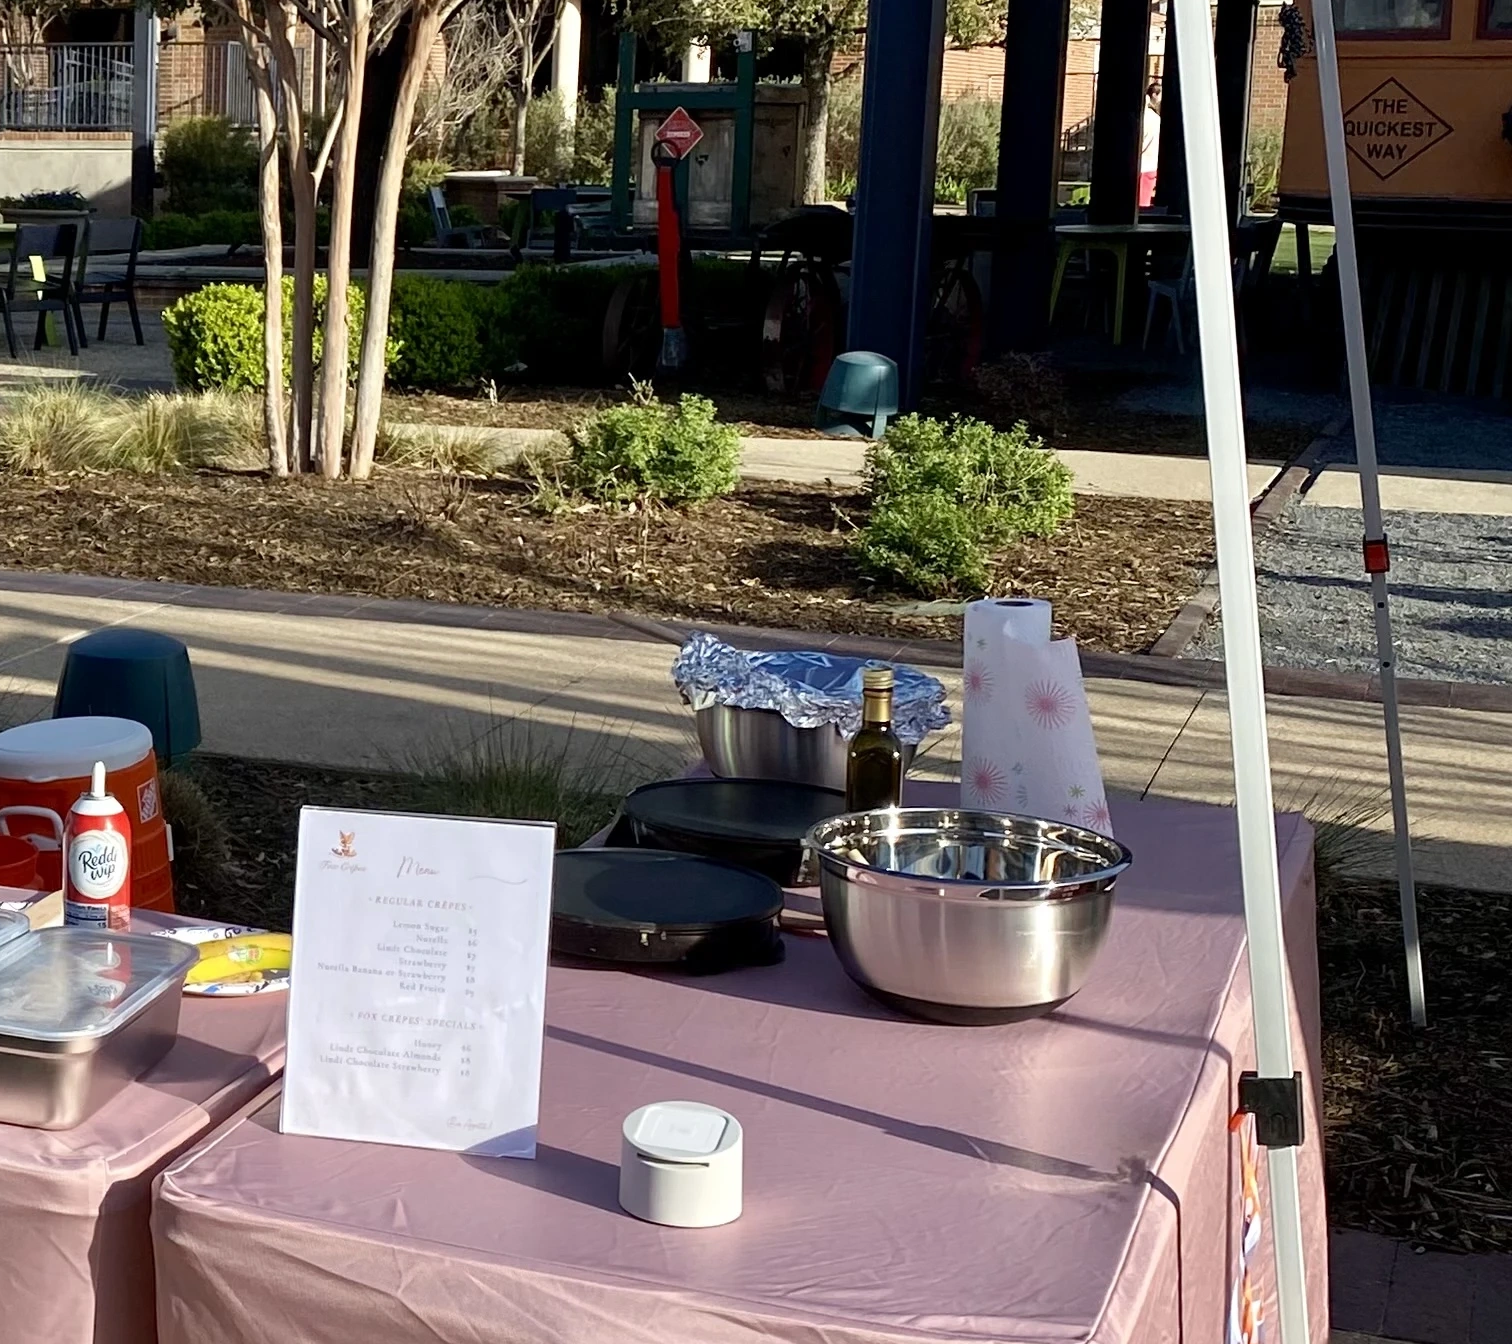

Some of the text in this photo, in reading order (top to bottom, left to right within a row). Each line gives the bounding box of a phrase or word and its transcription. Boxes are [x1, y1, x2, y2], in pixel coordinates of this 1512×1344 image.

[1372, 98, 1408, 114] THE
[1344, 120, 1438, 137] QUICKEST
[1366, 143, 1407, 160] WAY
[78, 846, 117, 873] Reddi
[396, 855, 441, 878] Menu
[91, 864, 116, 880] wip
[375, 896, 423, 908] REGULAR
[393, 920, 421, 930] Lemon
